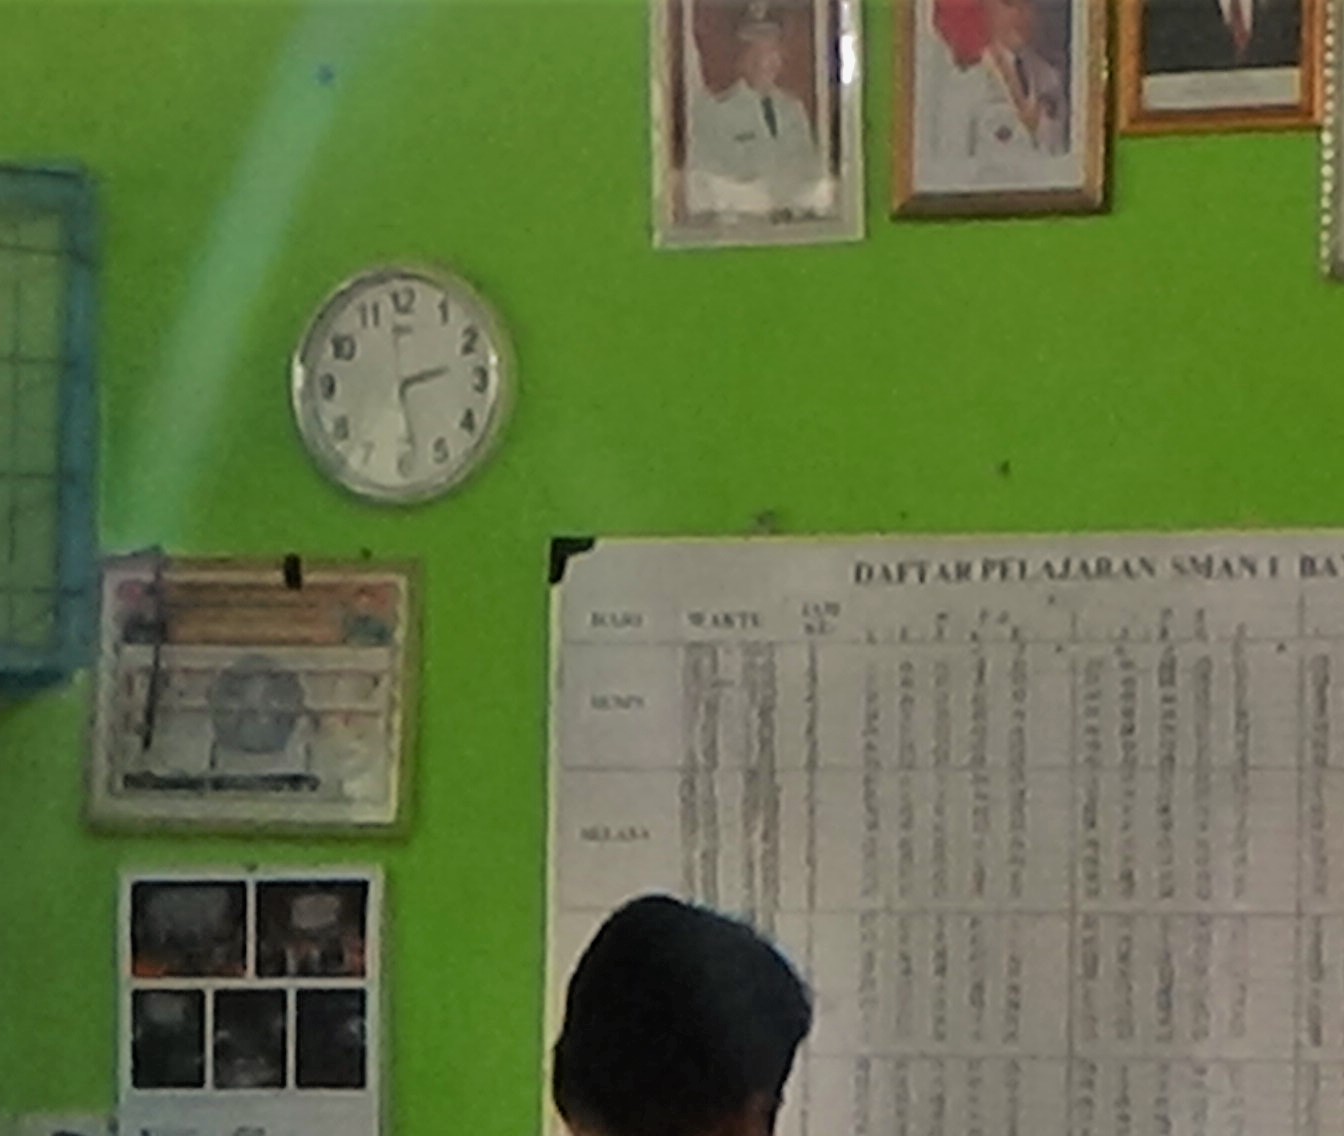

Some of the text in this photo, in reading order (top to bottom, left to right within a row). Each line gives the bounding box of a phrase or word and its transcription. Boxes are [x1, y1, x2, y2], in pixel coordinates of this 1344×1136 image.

[360, 302, 380, 328] 11
[389, 286, 416, 315] 12
[438, 300, 449, 326] 1
[331, 333, 356, 361] 10
[462, 325, 479, 356] 2
[473, 365, 489, 394] 3
[460, 408, 475, 437] 4
[433, 437, 449, 464] 5
[855, 560, 973, 586] DAFTAR
[980, 556, 1157, 583] PELAJARAN
[1170, 556, 1257, 580] SMAN
